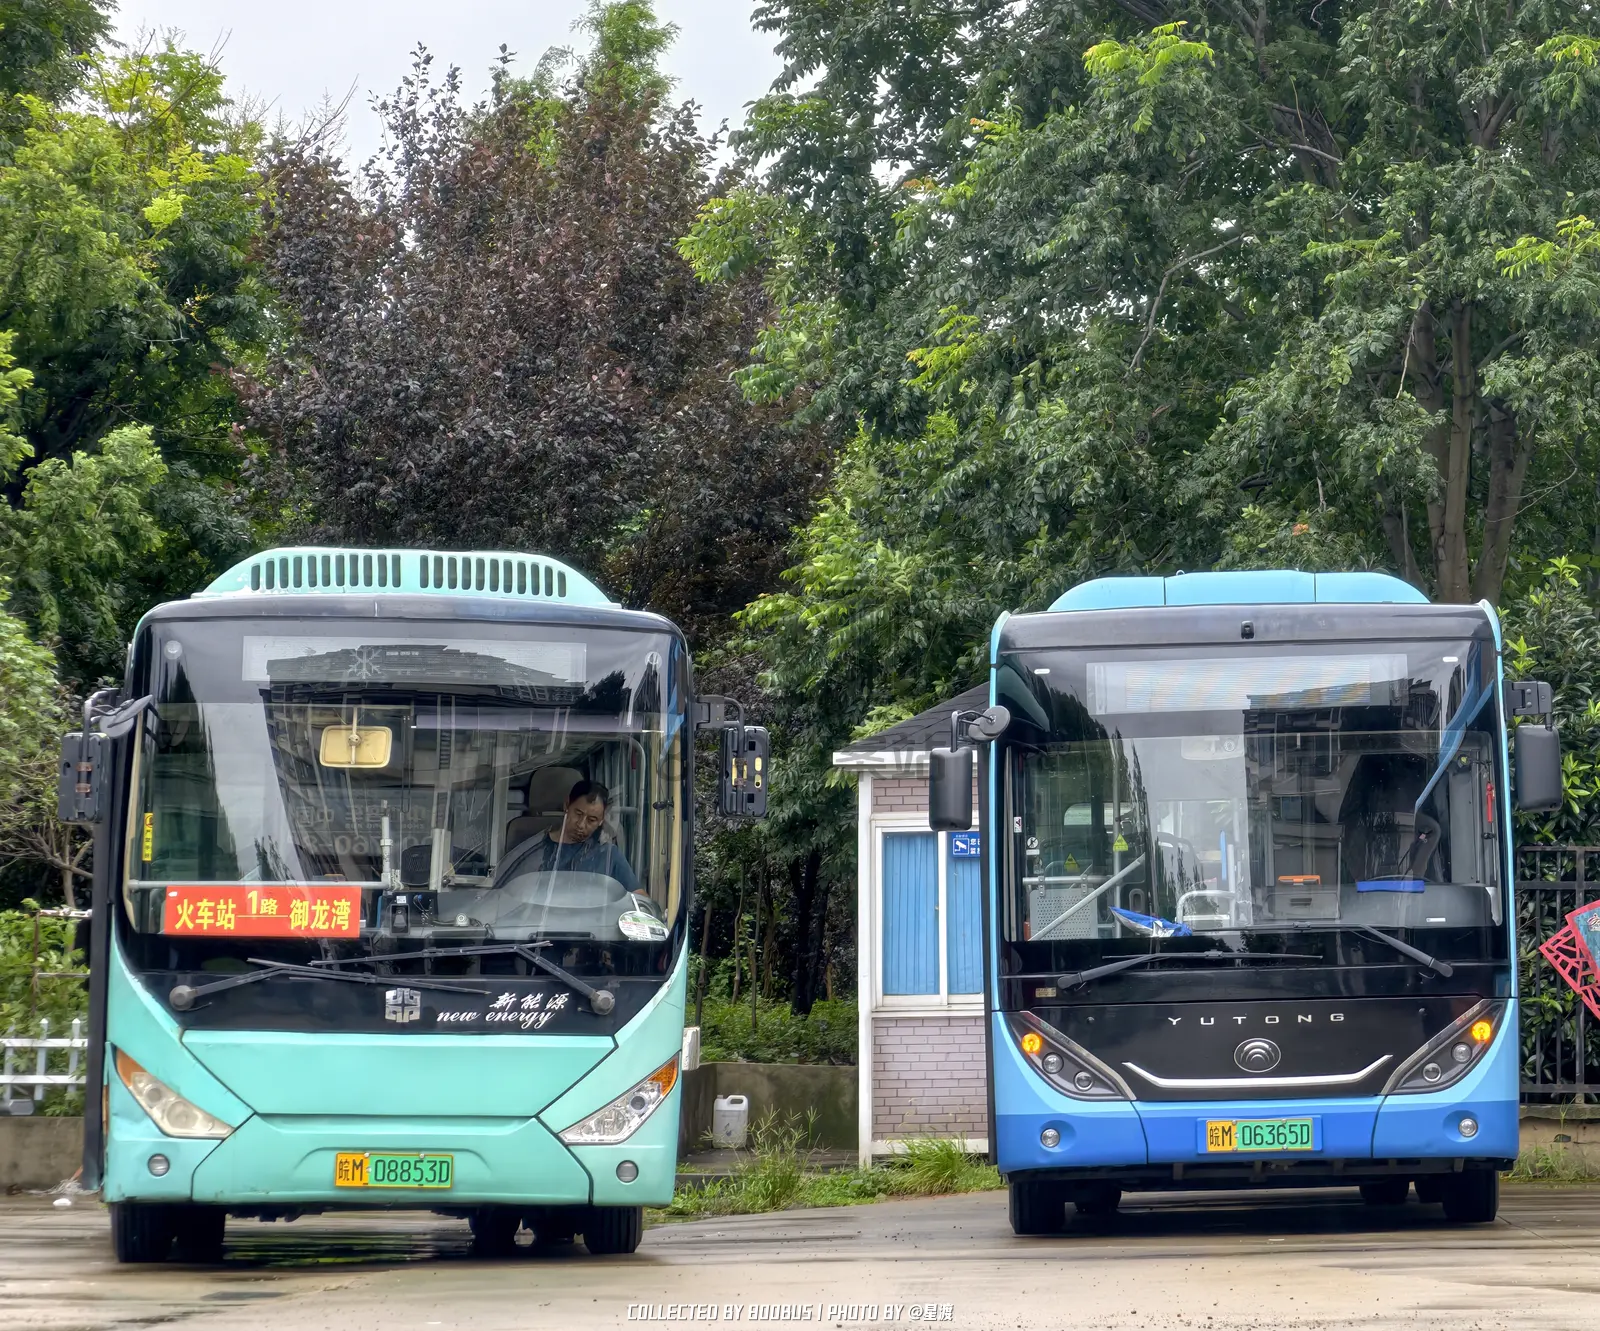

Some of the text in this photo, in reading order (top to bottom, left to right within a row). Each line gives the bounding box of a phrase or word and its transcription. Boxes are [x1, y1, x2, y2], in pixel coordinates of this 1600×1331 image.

[175, 890, 351, 931] 火车站 1路 御龙湾
[489, 992, 570, 1010] 新能源
[436, 1011, 556, 1029] new energy
[1168, 1013, 1345, 1026] YUTONG
